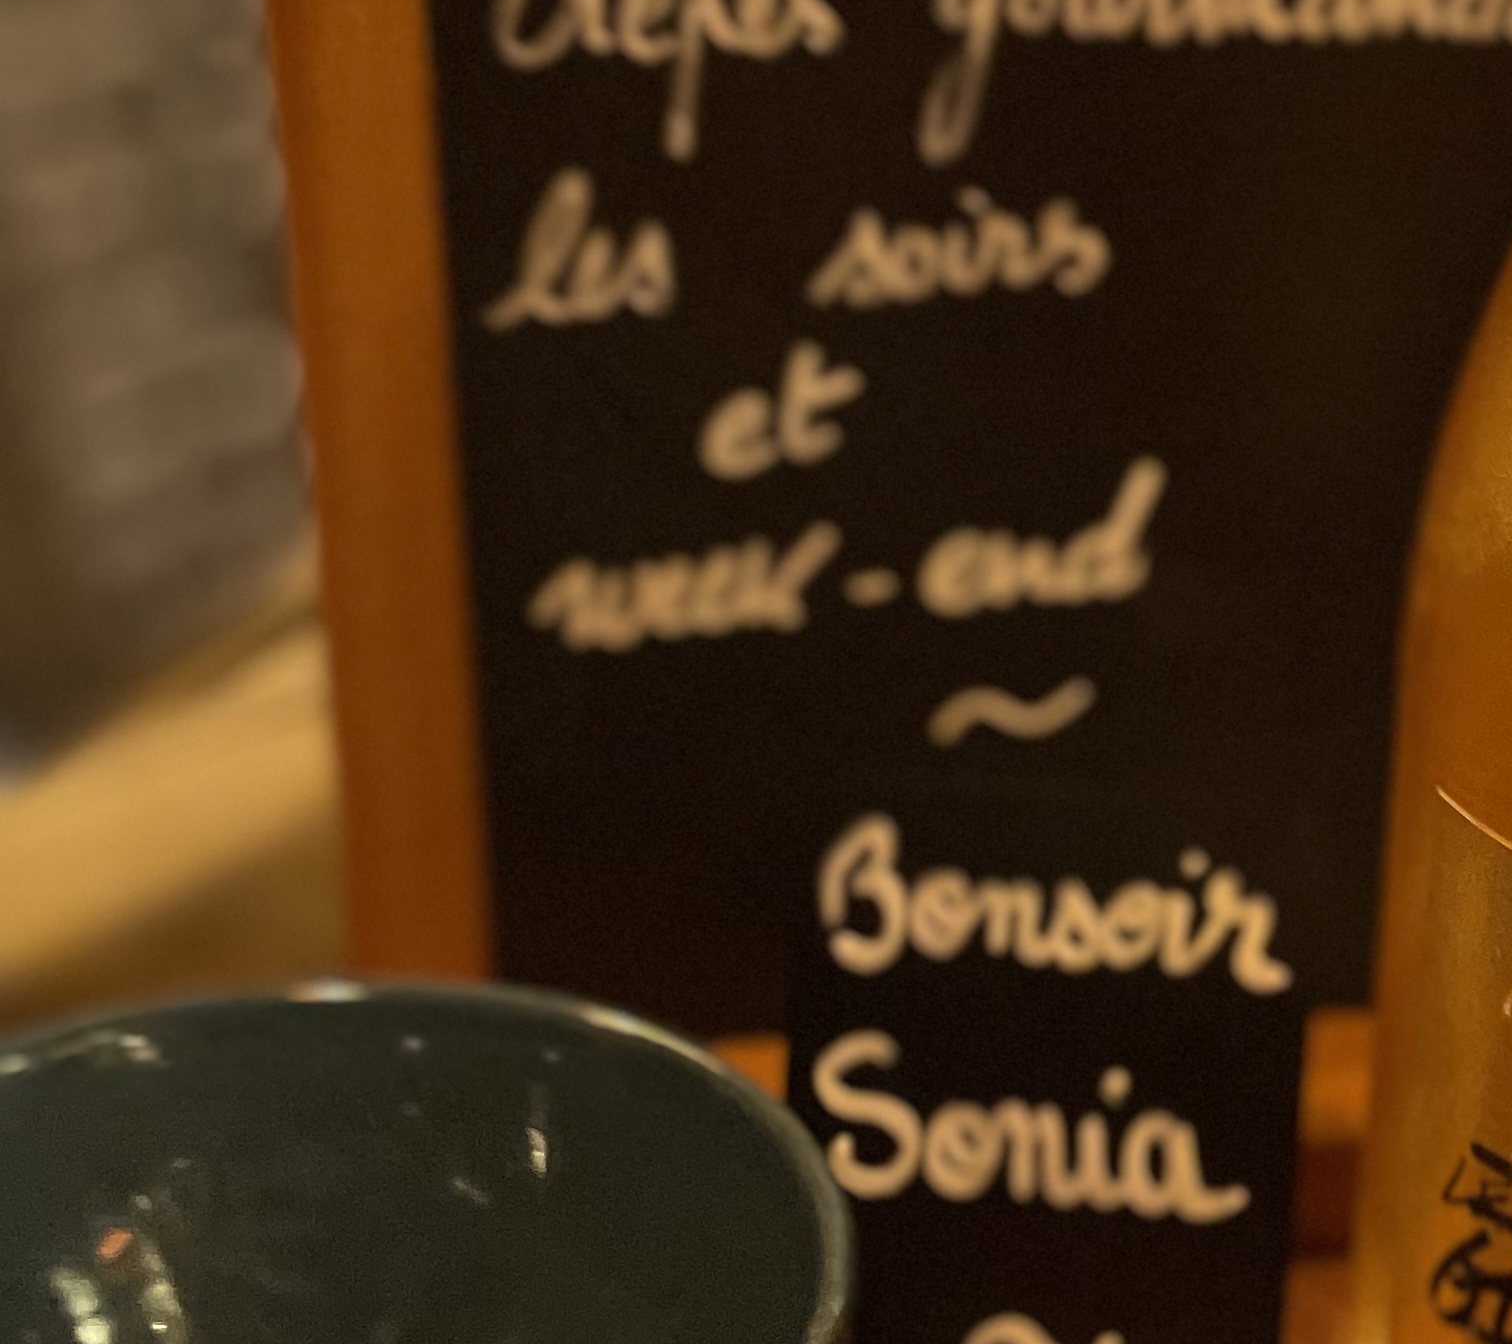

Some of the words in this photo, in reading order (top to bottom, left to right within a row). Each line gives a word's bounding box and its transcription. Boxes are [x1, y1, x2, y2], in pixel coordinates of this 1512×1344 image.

[806, 186, 1112, 308] soirs
[698, 340, 866, 480] et
[818, 814, 1293, 996] Bonsoir
[811, 1029, 1251, 1223] Sonia
